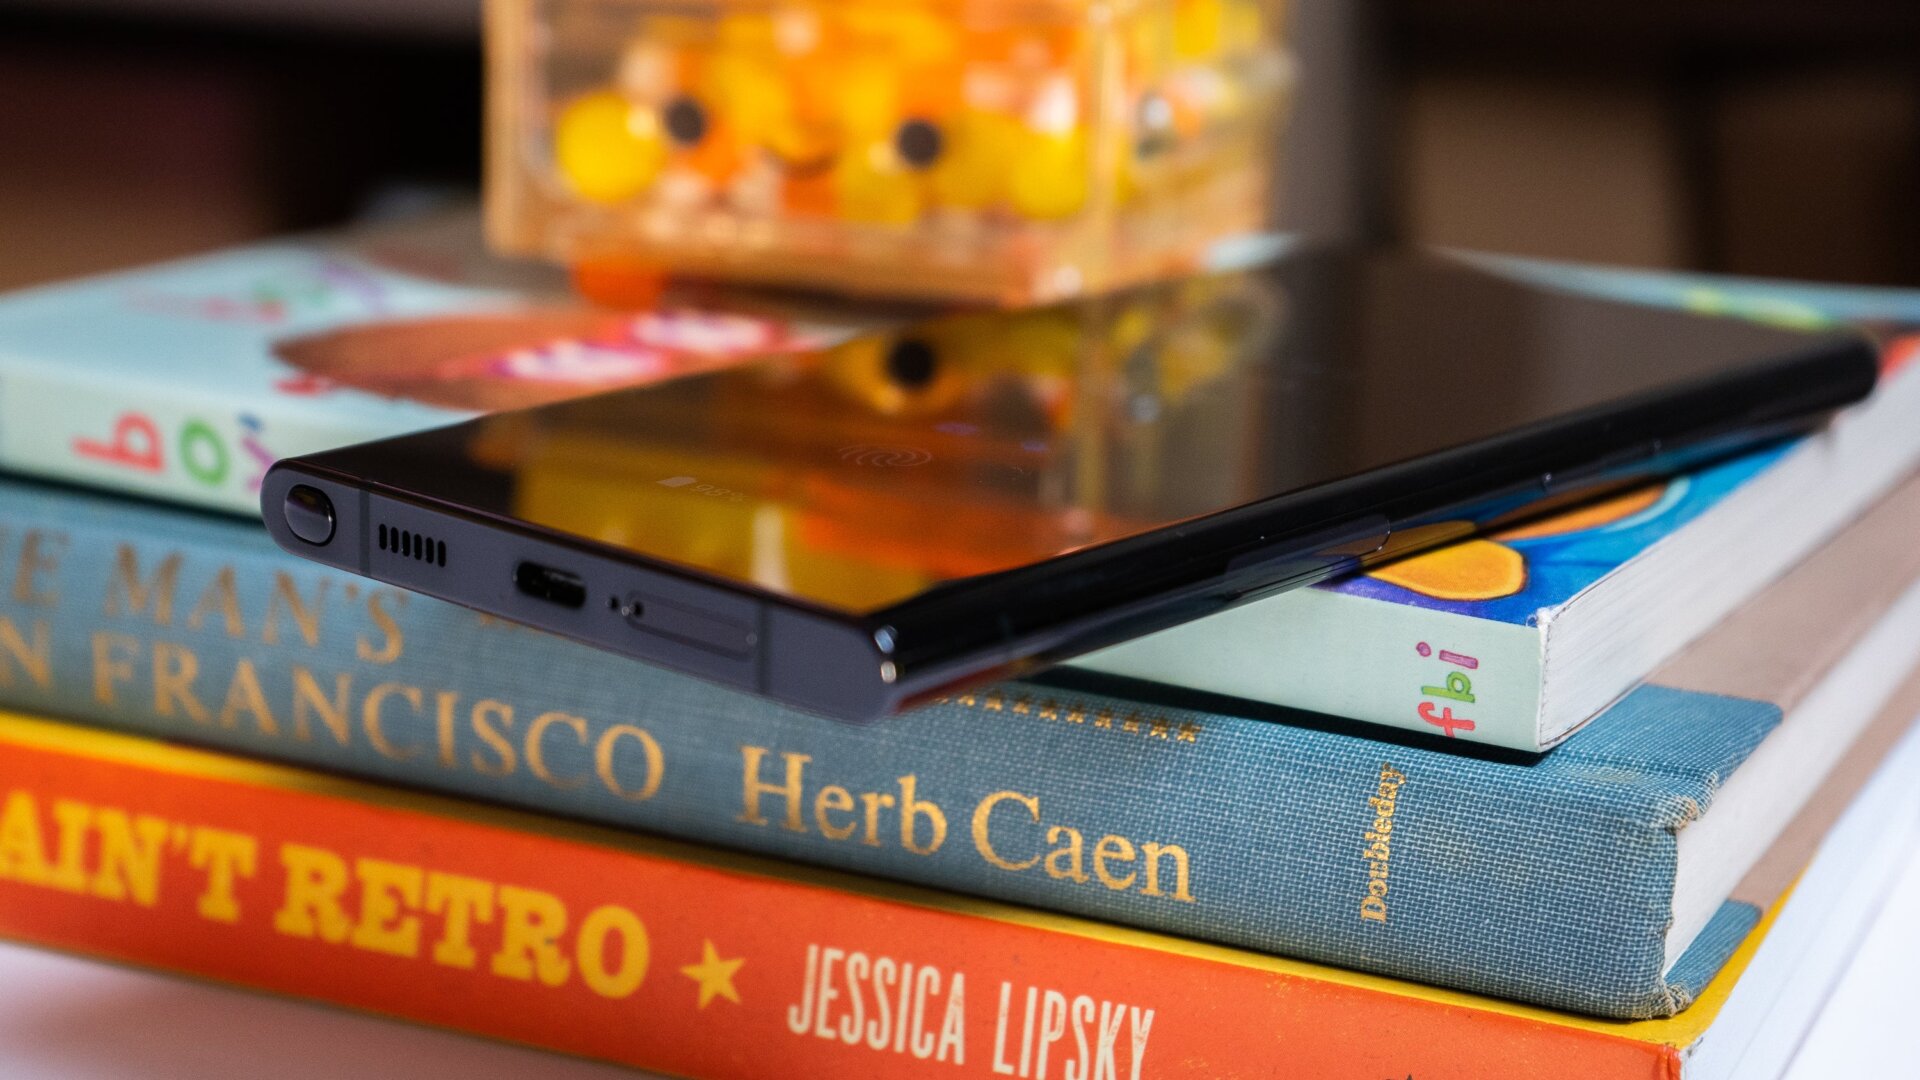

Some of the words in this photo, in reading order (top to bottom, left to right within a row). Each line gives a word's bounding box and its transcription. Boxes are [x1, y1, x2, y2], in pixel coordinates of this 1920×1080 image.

[0, 527, 72, 608] E
[103, 542, 406, 665] MAN'S
[91, 630, 665, 802] FRANCISCO
[0, 789, 257, 923] AIN'T
[273, 841, 650, 999] RETRO
[736, 745, 948, 856] Herb
[972, 790, 1197, 902] Caen
[1360, 762, 1407, 924] Doubleday
[787, 943, 965, 1066] JESSICA
[992, 980, 1156, 1080] LIPSKY
